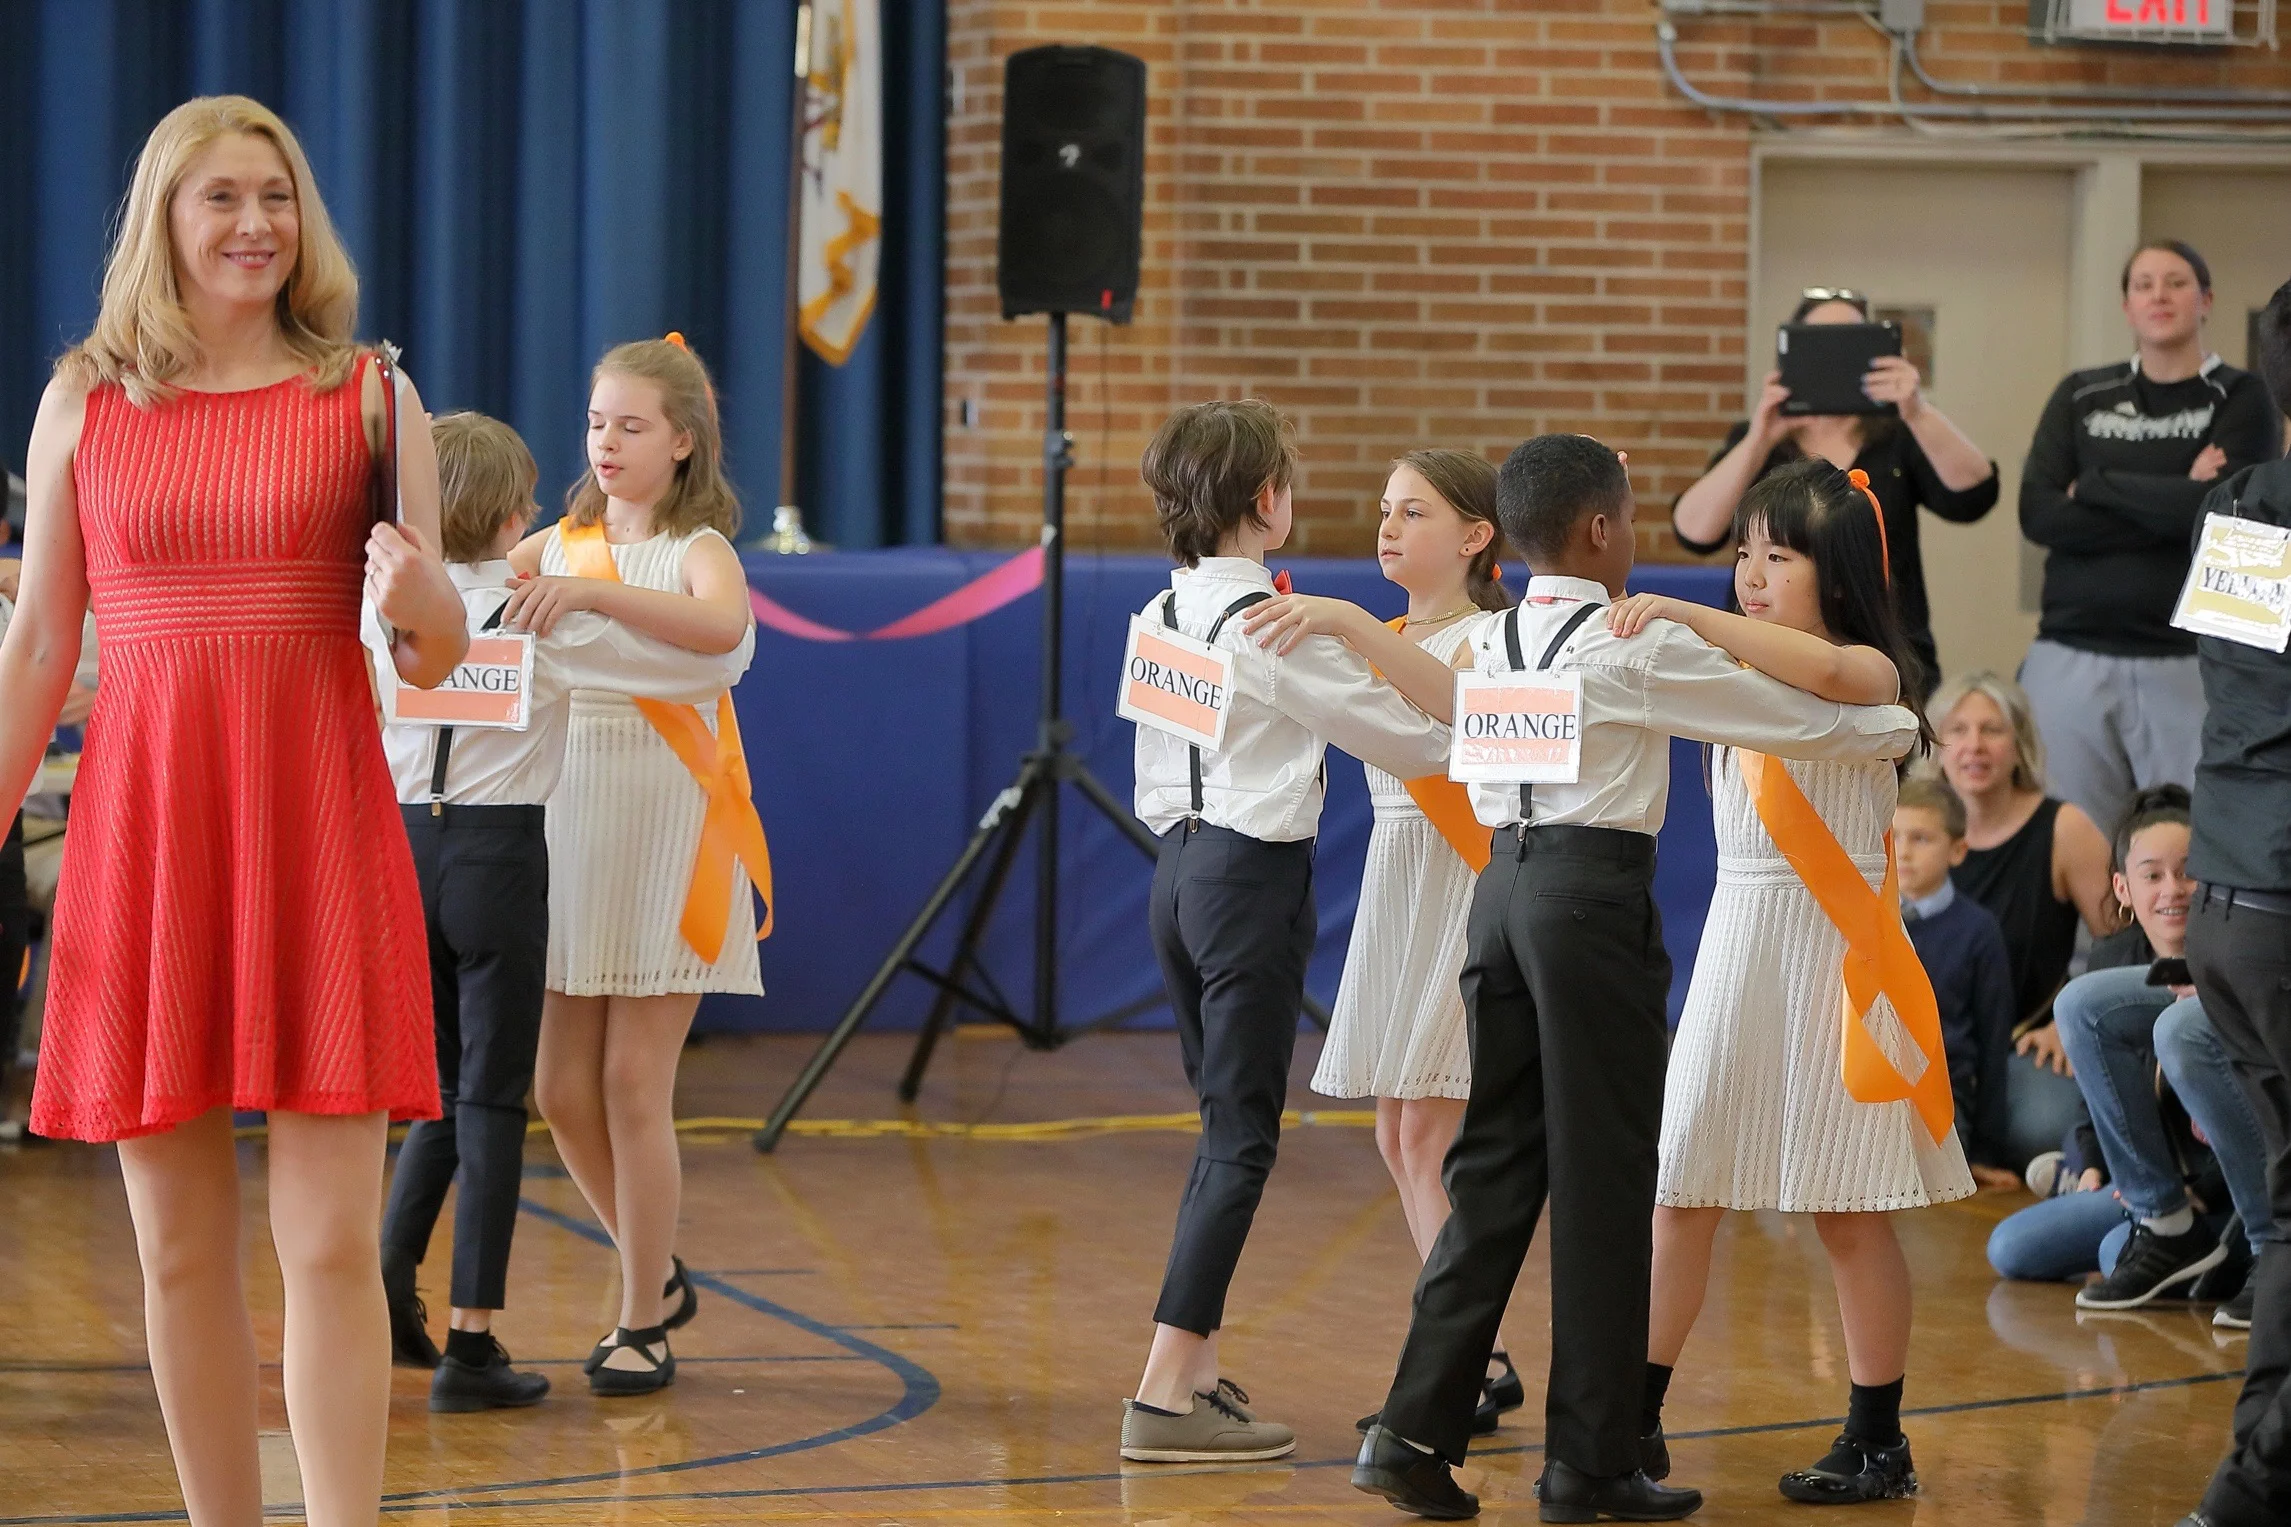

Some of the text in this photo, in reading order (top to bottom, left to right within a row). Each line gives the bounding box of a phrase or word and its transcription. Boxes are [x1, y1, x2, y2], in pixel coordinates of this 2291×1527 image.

[440, 666, 519, 692] ANGE
[1130, 656, 1223, 711] ORANGE
[1464, 713, 1577, 740] ORANGE
